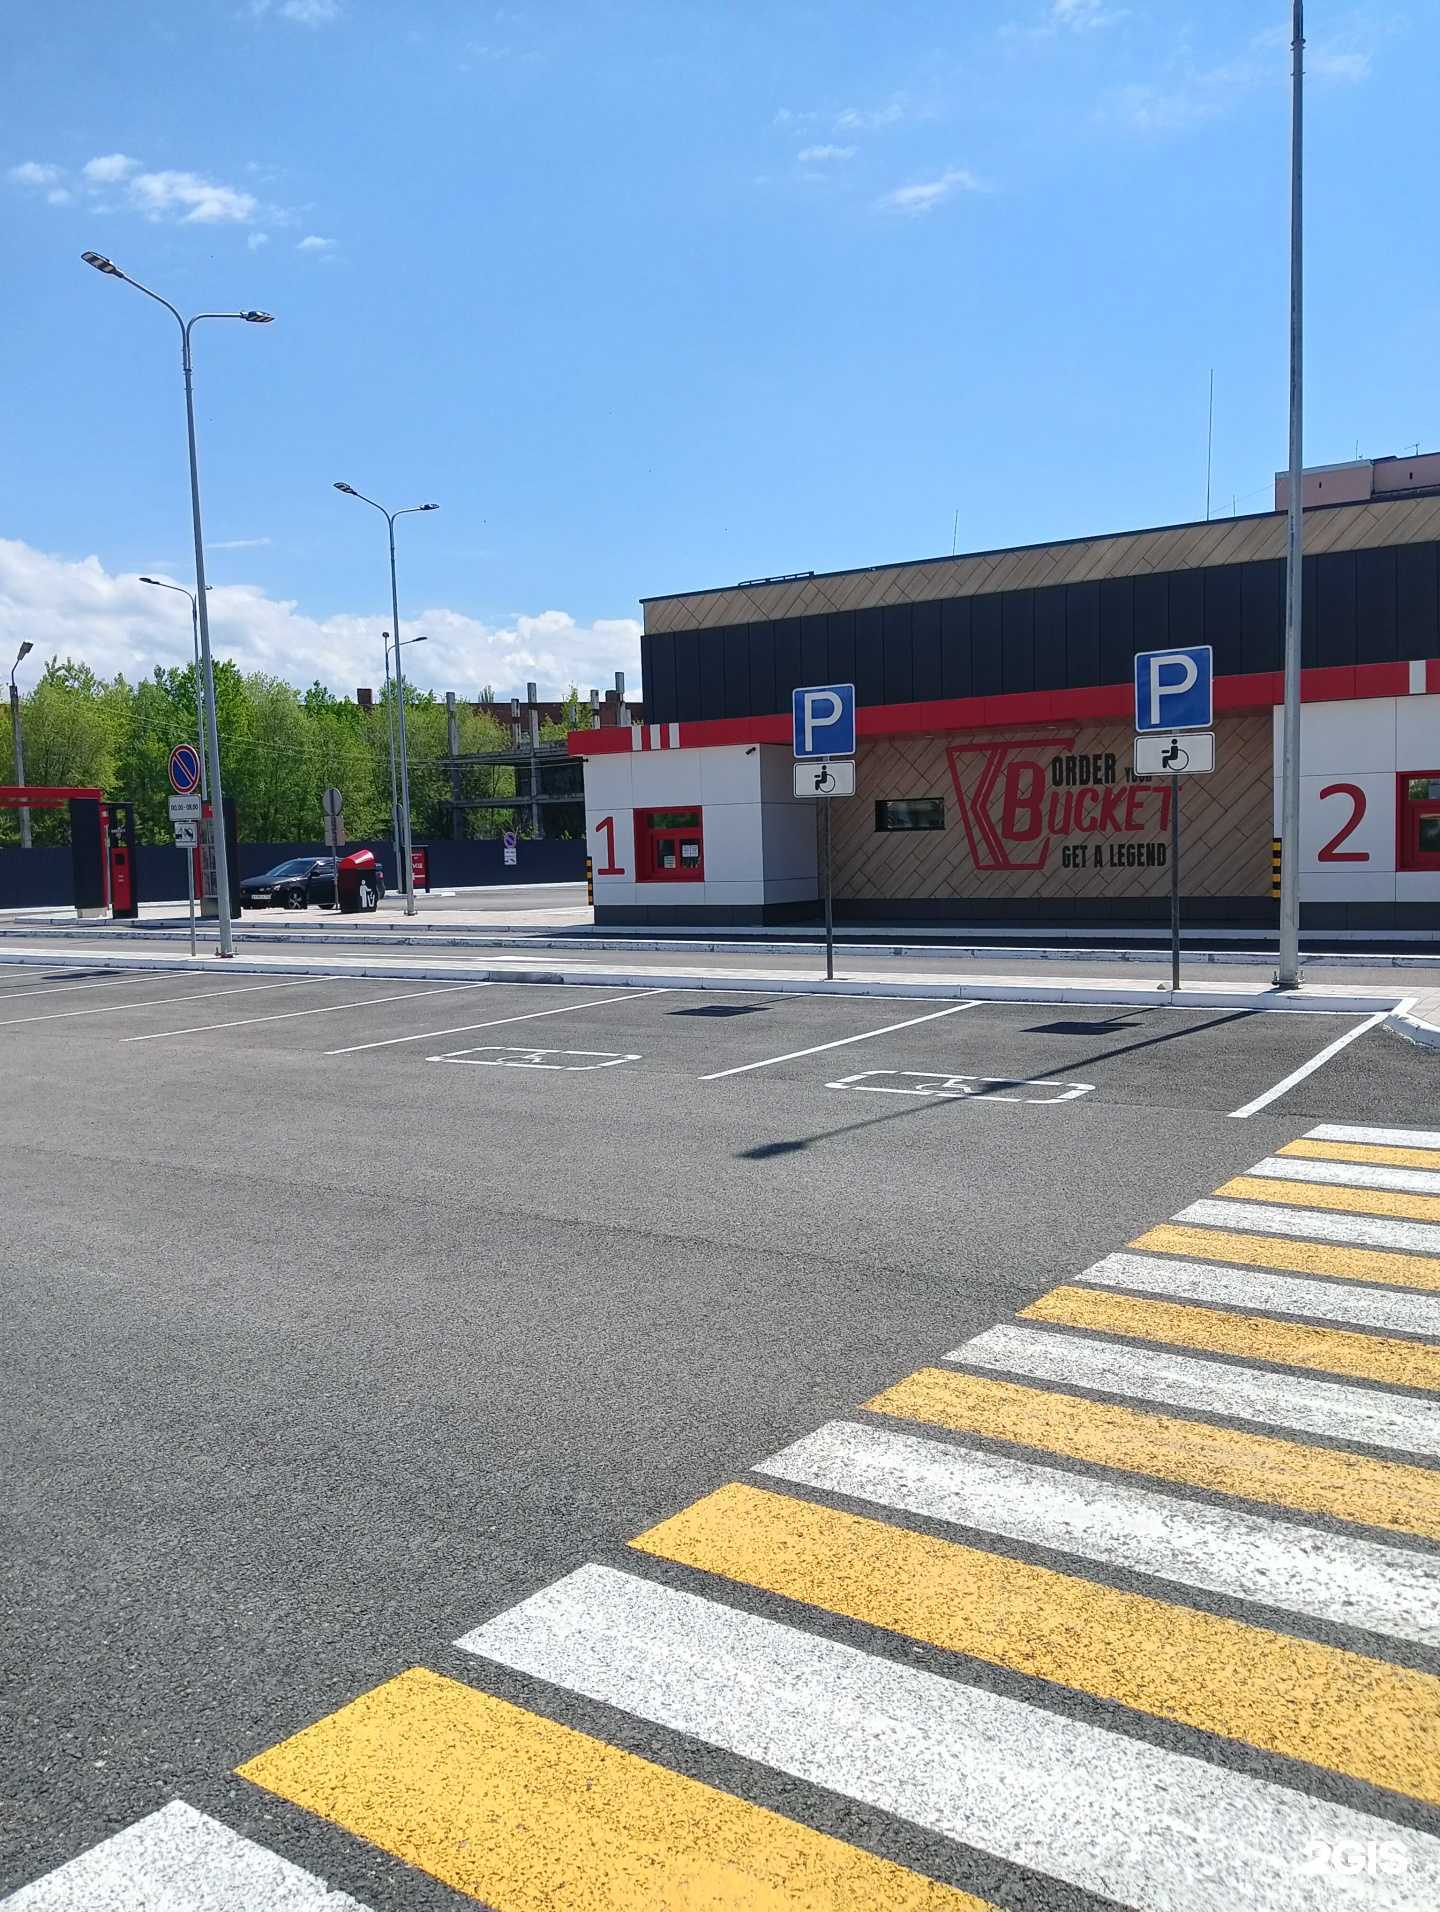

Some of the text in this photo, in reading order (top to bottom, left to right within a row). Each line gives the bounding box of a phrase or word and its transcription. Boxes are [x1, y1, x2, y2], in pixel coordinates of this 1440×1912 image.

[1149, 654, 1198, 725] P
[804, 691, 843, 752] P
[1052, 752, 1117, 787] ORDER
[1002, 761, 1182, 842] BUCKET
[1317, 783, 1370, 862] 2
[595, 816, 625, 875] 1
[1062, 842, 1167, 869] GET A LEGEND
